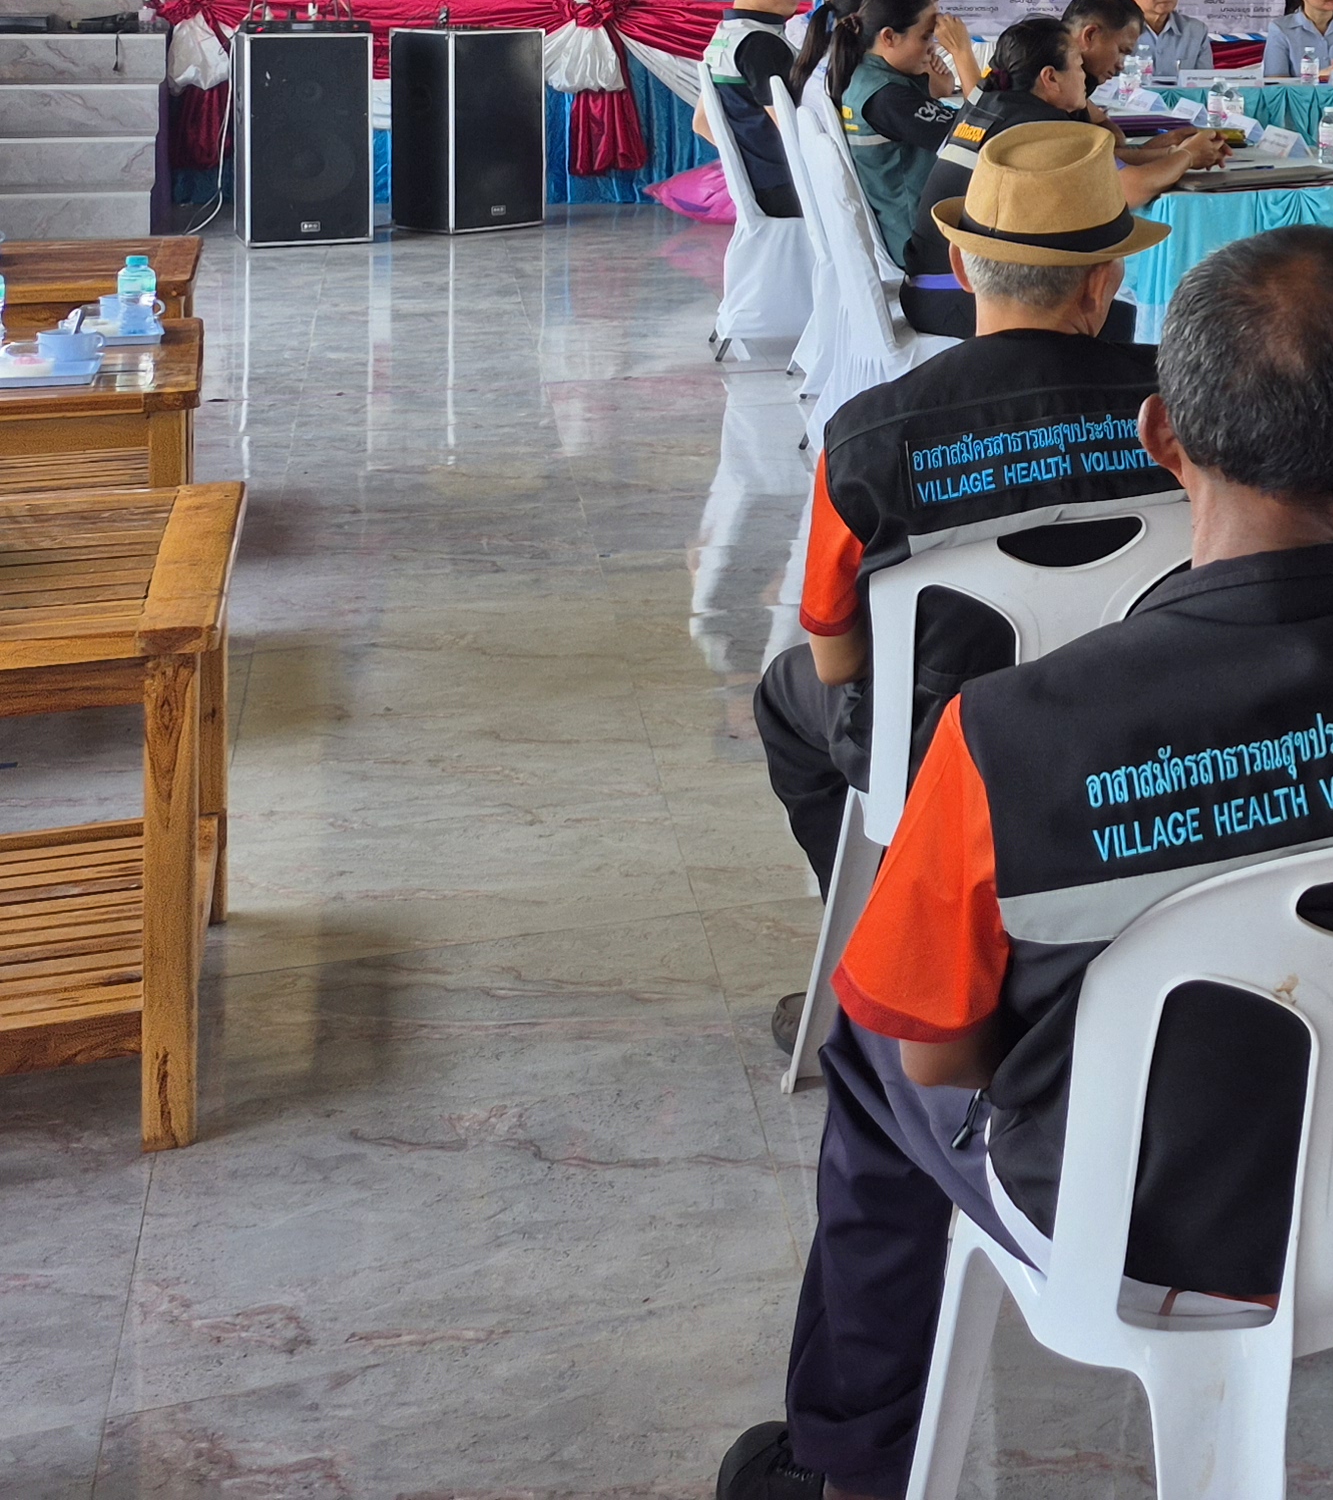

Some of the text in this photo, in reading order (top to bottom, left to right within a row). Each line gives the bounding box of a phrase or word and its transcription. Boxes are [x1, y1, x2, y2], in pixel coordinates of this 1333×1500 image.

[911, 413, 1141, 473] อาสาสมัครสาธารณสุขประจำห
[916, 449, 1159, 504] VILLAGE HEALTH VOLUNTE
[1092, 807, 1204, 863] VILLAGE
[1213, 784, 1310, 836] HEALTH
